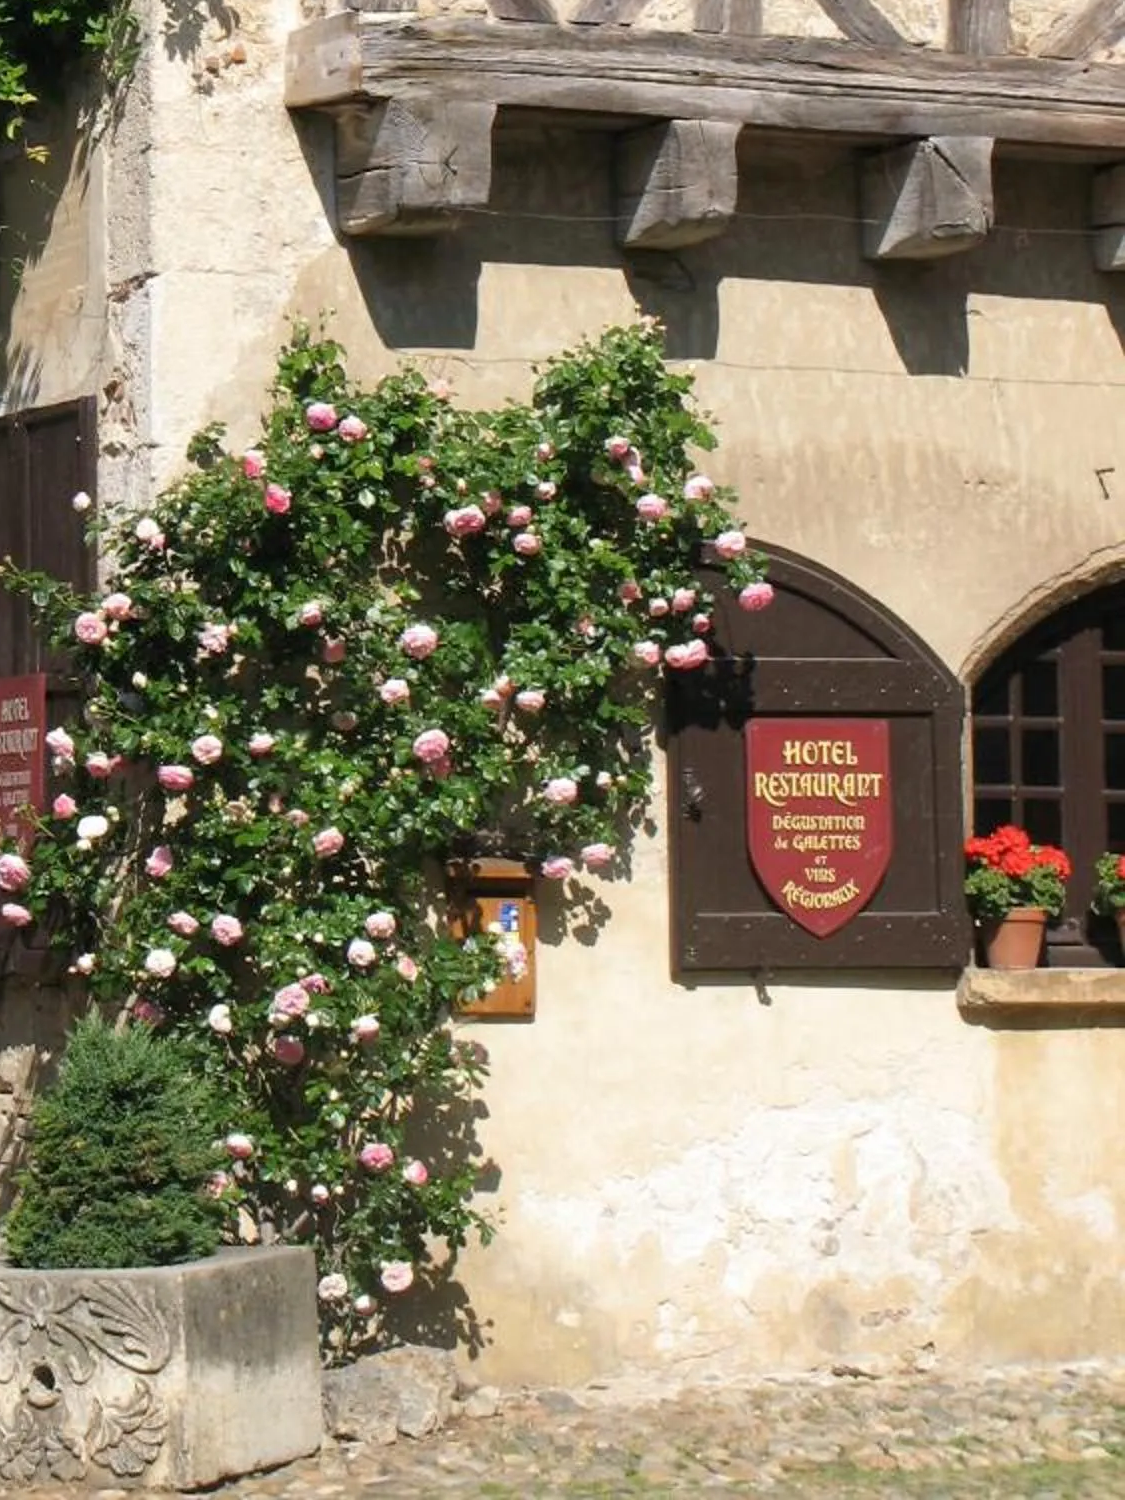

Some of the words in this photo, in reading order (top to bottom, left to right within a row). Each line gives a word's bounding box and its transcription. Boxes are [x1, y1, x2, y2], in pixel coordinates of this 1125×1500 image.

[782, 740, 859, 766] HOTEL
[755, 772, 882, 807] RESTAURANT
[772, 812, 866, 831] DÉGUSTATION
[774, 835, 789, 850] de
[792, 834, 862, 852] GALETTES
[804, 867, 836, 883] VINS
[781, 878, 860, 908] RÉGIONAUX
